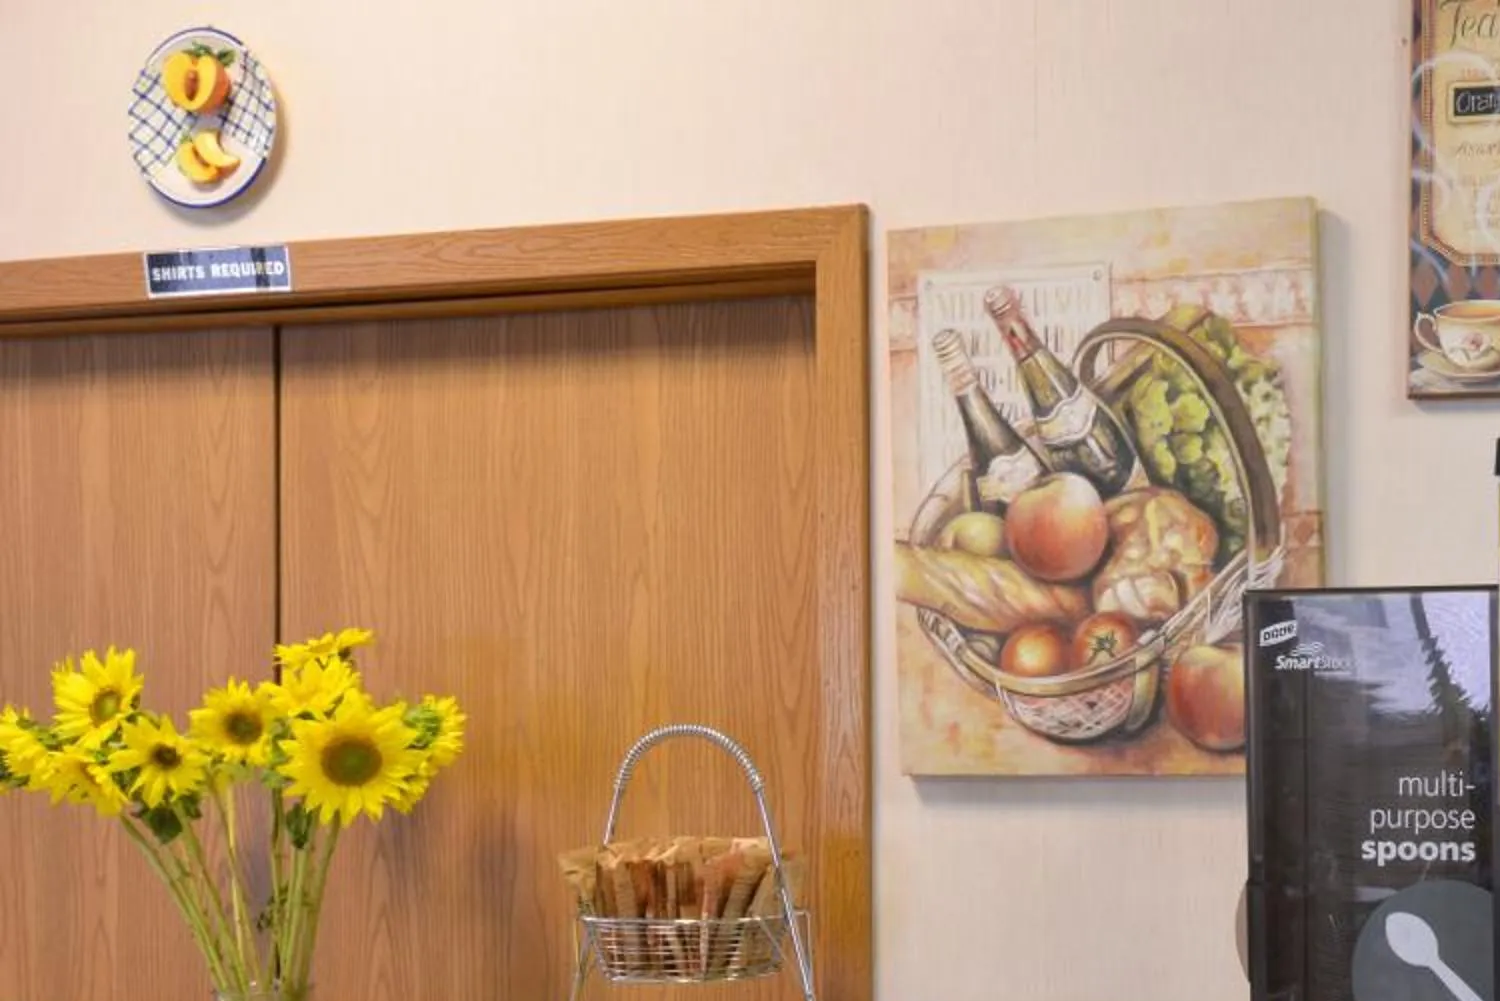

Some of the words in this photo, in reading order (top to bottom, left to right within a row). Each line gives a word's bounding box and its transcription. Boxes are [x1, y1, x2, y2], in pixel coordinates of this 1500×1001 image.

[1440, 0, 1498, 47] Tea
[152, 265, 205, 281] SHIRTS
[211, 261, 284, 278] REQUIRED
[1398, 769, 1476, 798] multi-
[1369, 807, 1476, 837] purpose
[1361, 839, 1476, 866] spoons
